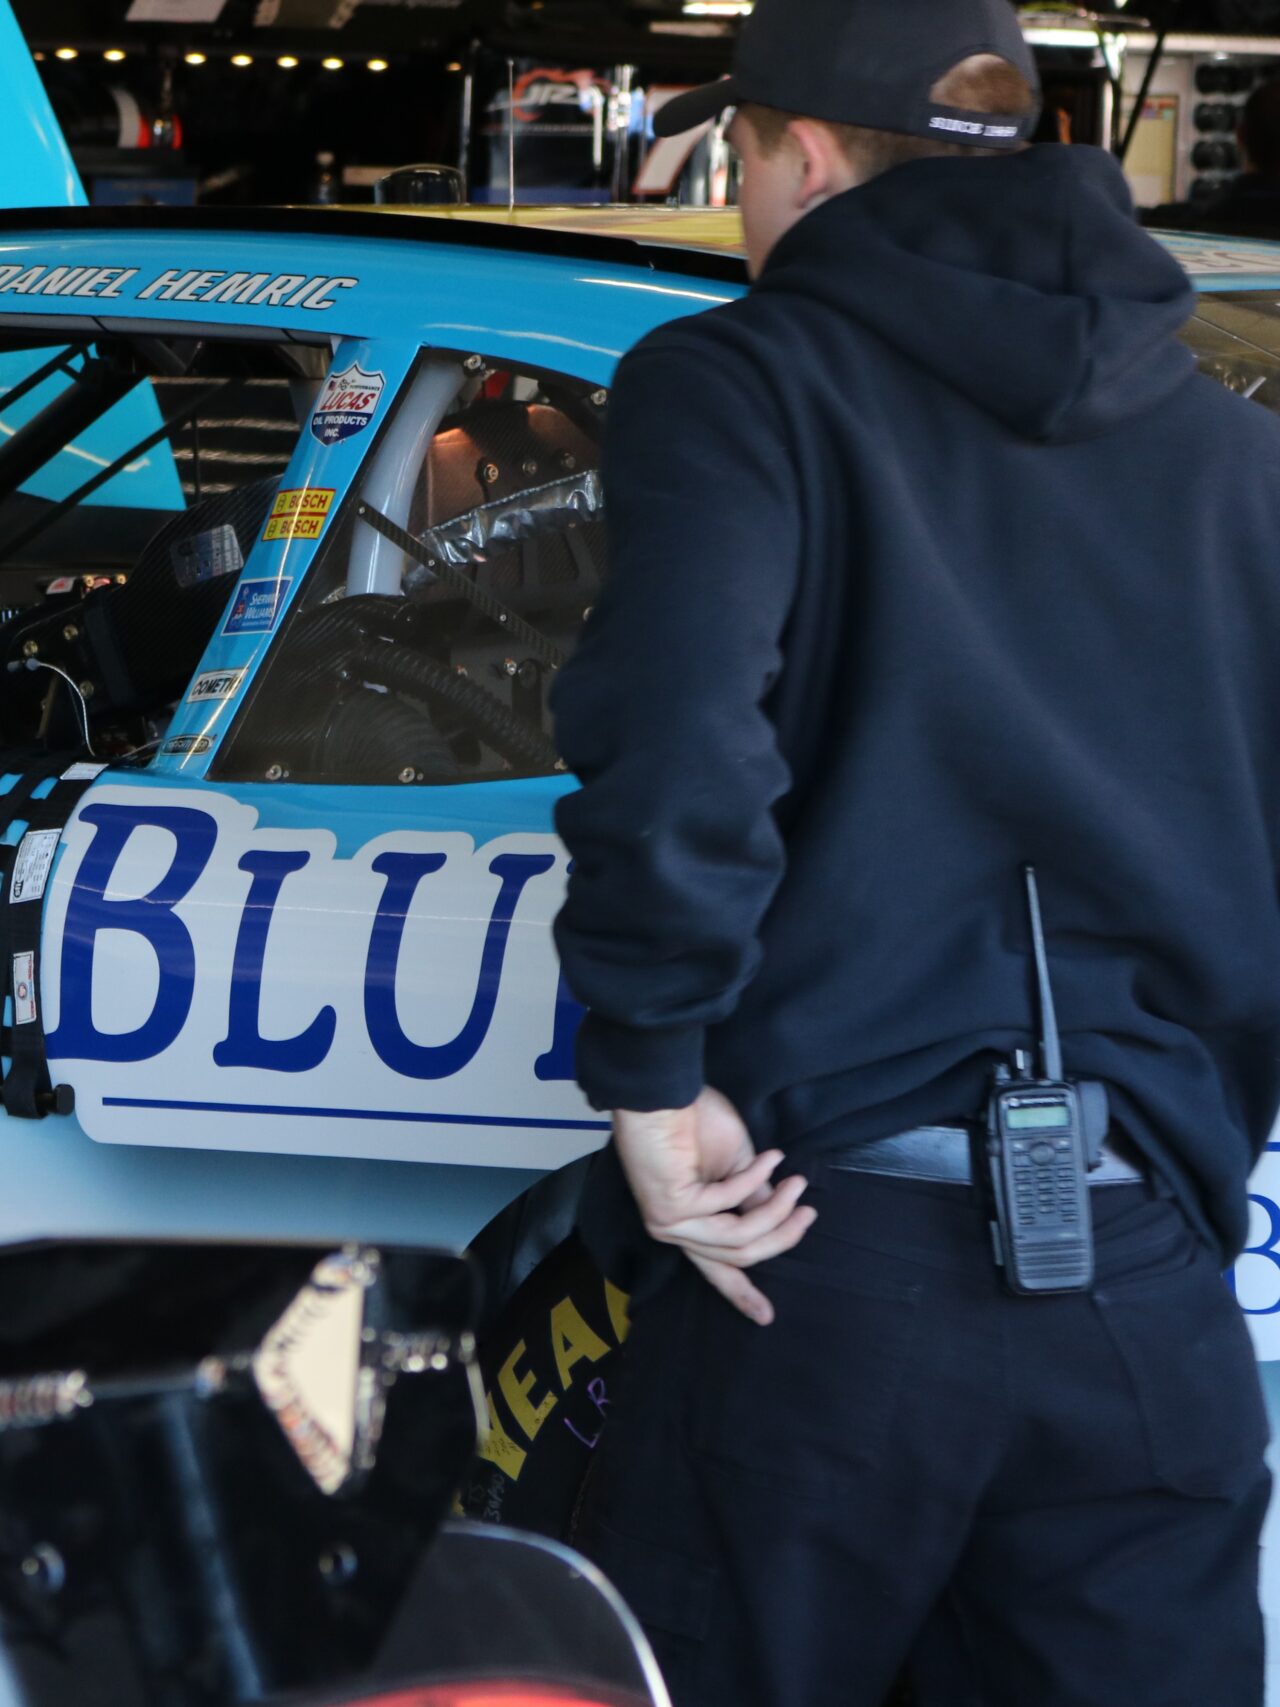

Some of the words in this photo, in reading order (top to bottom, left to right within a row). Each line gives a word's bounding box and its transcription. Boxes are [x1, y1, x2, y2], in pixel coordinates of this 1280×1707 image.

[136, 269, 360, 311] HEMRIC
[320, 391, 377, 411] LUCAS
[324, 414, 368, 426] PRODUCTS
[288, 494, 329, 509] BOSCH
[279, 519, 319, 534] BOSCH
